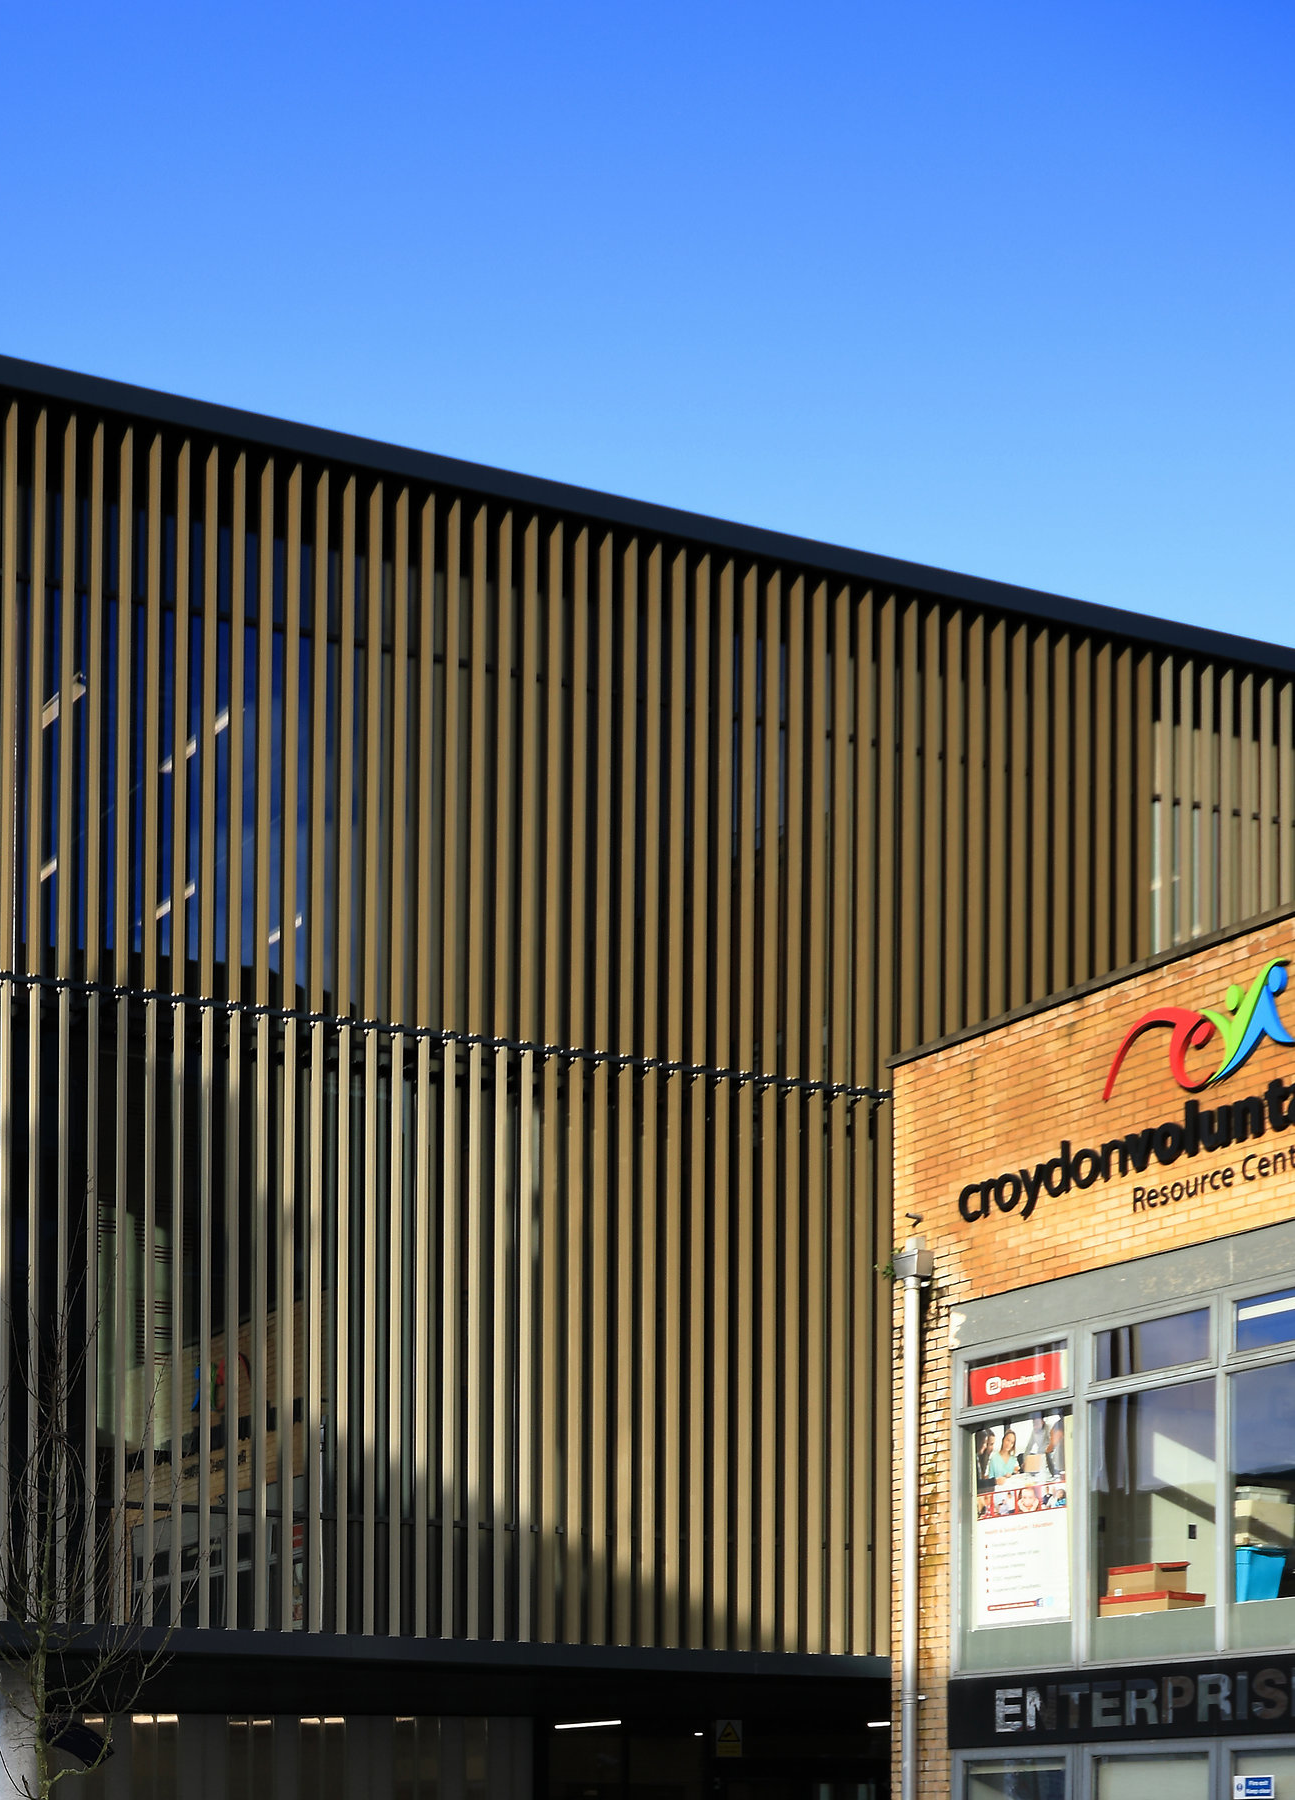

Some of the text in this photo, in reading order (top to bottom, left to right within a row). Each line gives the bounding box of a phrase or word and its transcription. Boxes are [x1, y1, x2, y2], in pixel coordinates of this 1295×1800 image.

[1133, 1166, 1235, 1213] Resource
[1001, 1372, 1046, 1388] Recruitment
[995, 1667, 1295, 1733] ENTERPRIS
